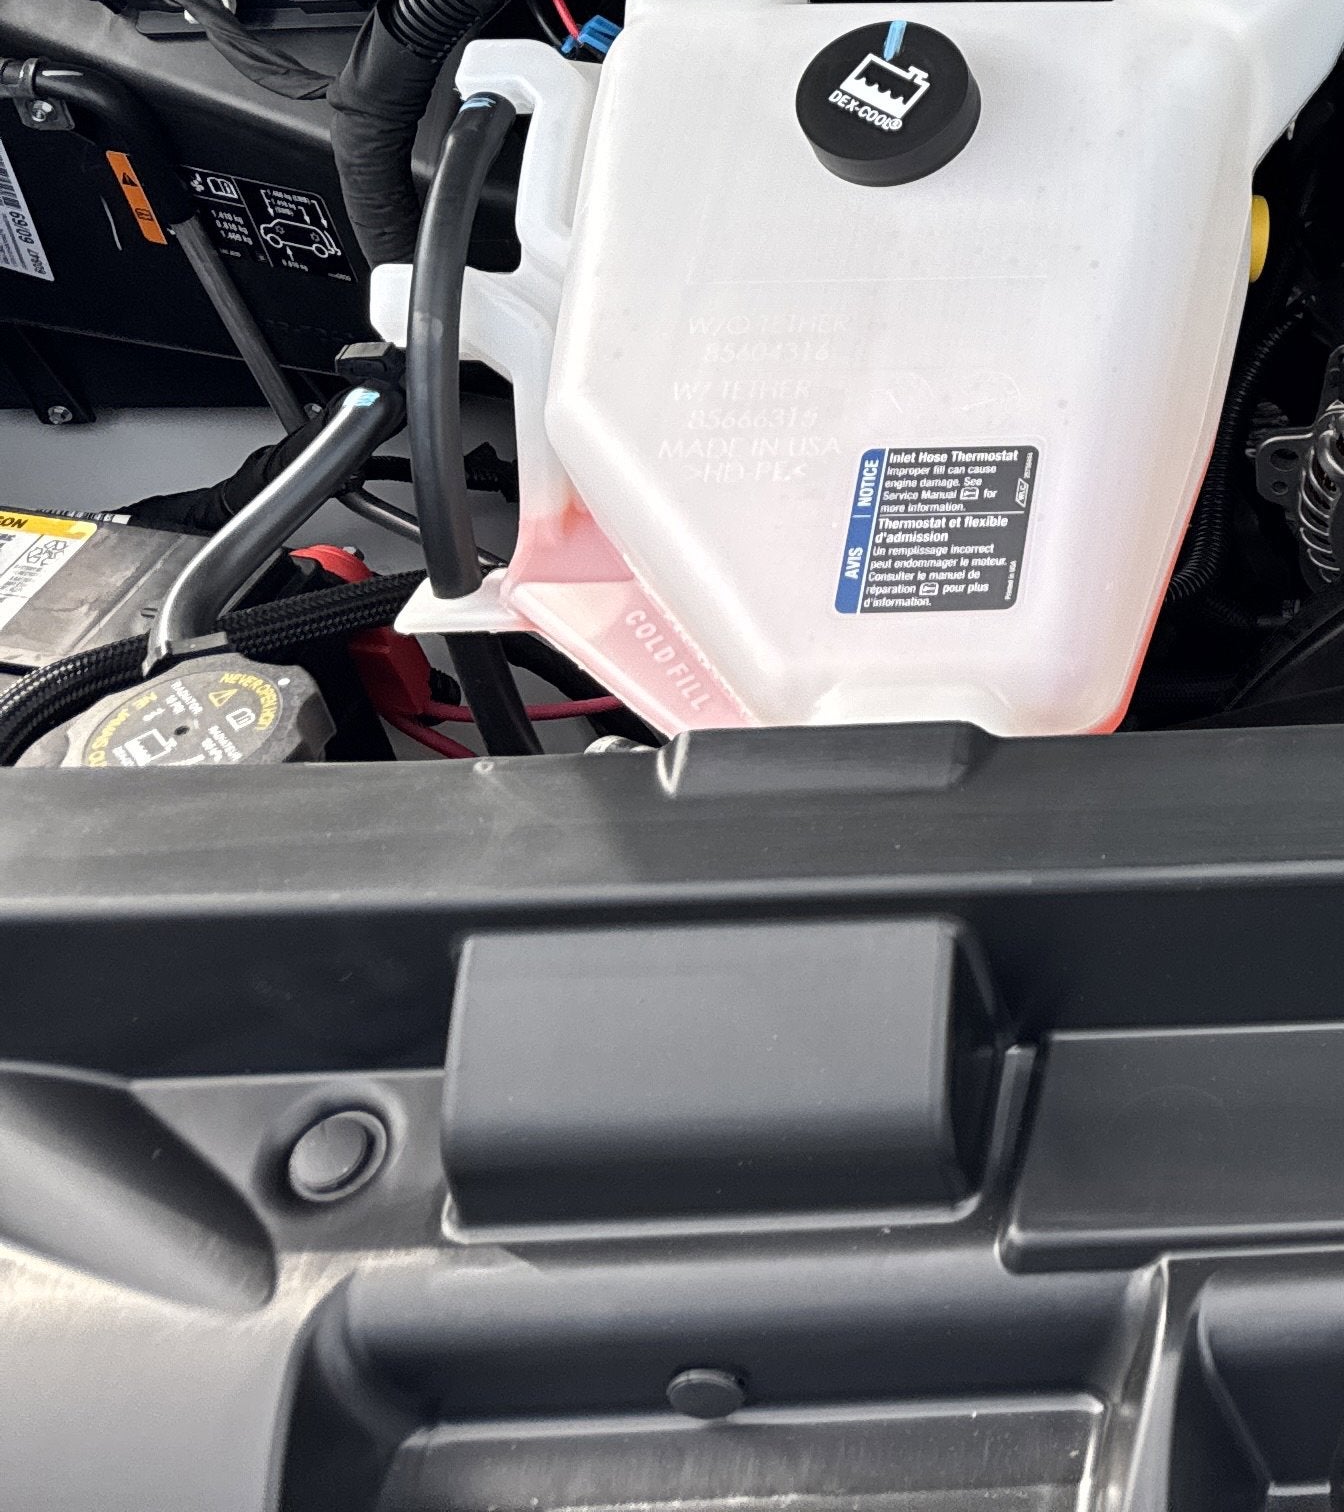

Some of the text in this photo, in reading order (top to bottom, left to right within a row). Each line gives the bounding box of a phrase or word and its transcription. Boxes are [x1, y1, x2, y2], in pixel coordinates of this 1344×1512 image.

[657, 436, 843, 460] MADE IN USA
[889, 450, 1018, 464] Inlet Hose Thermostat
[887, 465, 997, 477] Improper fill can cause
[857, 459, 879, 507] NOTICE
[884, 477, 983, 489] engine damage. See
[882, 489, 998, 501] Service Manual for
[880, 502, 966, 513] more information.
[878, 516, 1009, 530] Thermostat et flexible
[875, 531, 949, 544] d'admission
[872, 544, 994, 557] Un remplissage incorrect
[844, 547, 863, 580] AVIS
[870, 557, 1008, 570] peut endommager le moteur.
[868, 569, 981, 582] Consulter le manuel de
[865, 582, 989, 595] réparation pour plus
[863, 596, 932, 608] d'information.
[625, 609, 710, 711] COLD FILL
